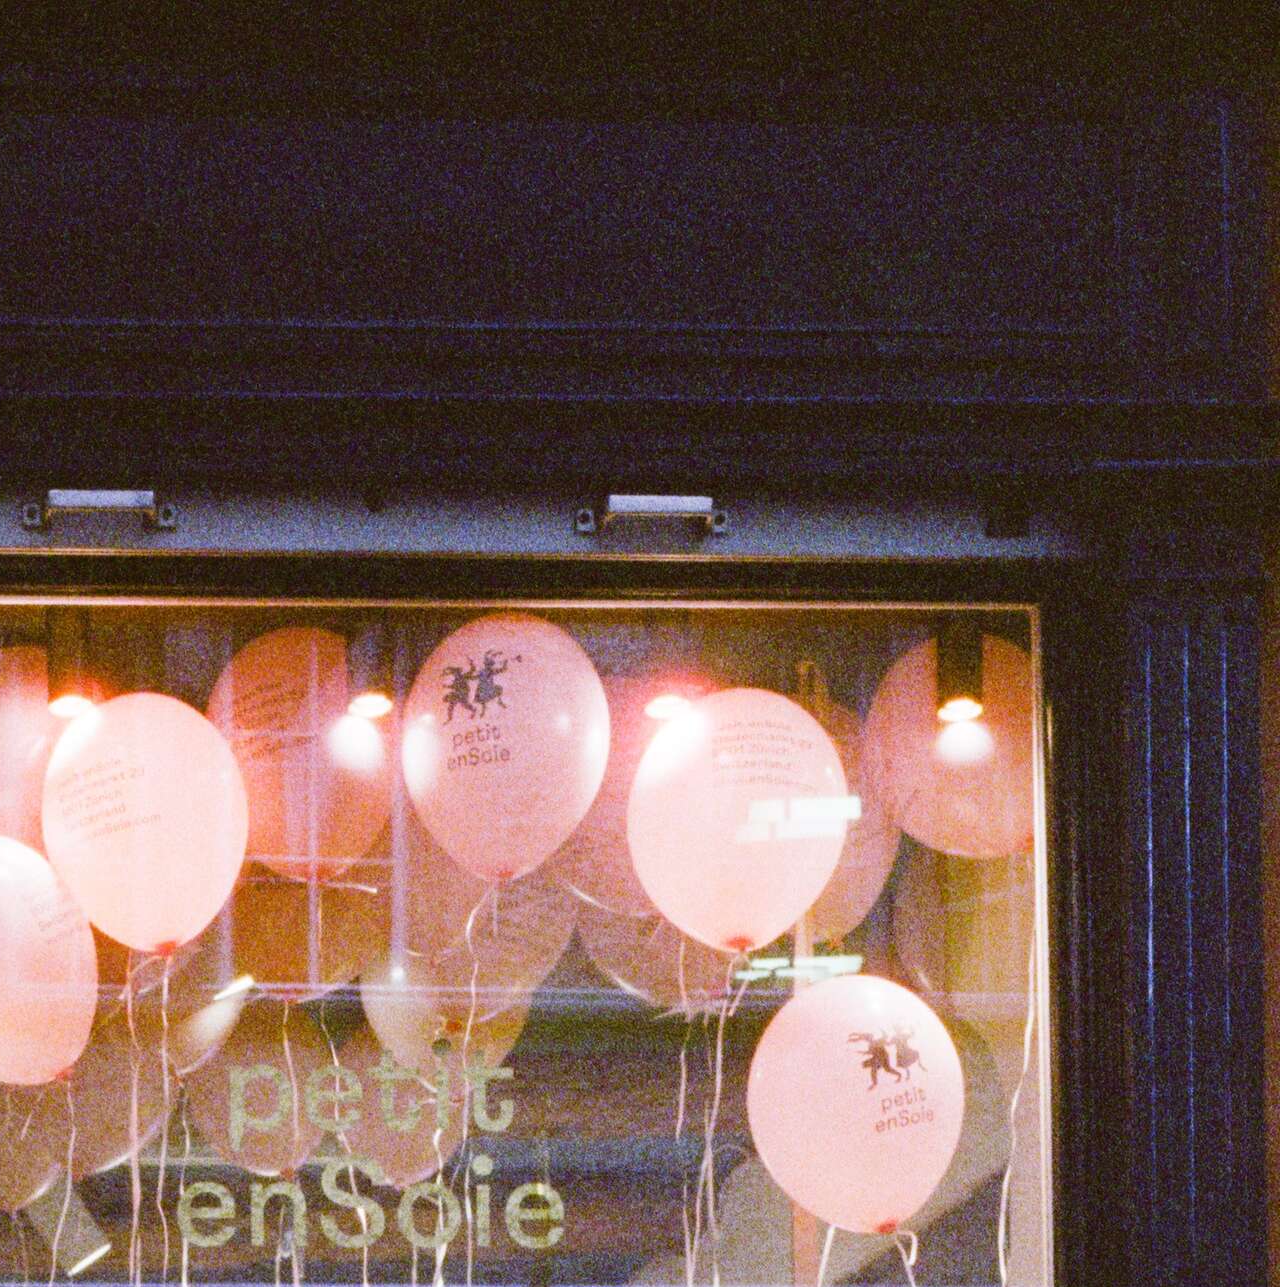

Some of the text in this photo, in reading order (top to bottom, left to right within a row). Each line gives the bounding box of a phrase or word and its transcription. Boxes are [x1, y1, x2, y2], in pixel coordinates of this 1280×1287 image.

[452, 724, 501, 751] petit
[447, 745, 511, 770] enSoie
[229, 1038, 514, 1152] petit
[881, 1087, 926, 1114] petit
[875, 1105, 934, 1133] enSoie
[178, 1154, 565, 1249] enSoie
